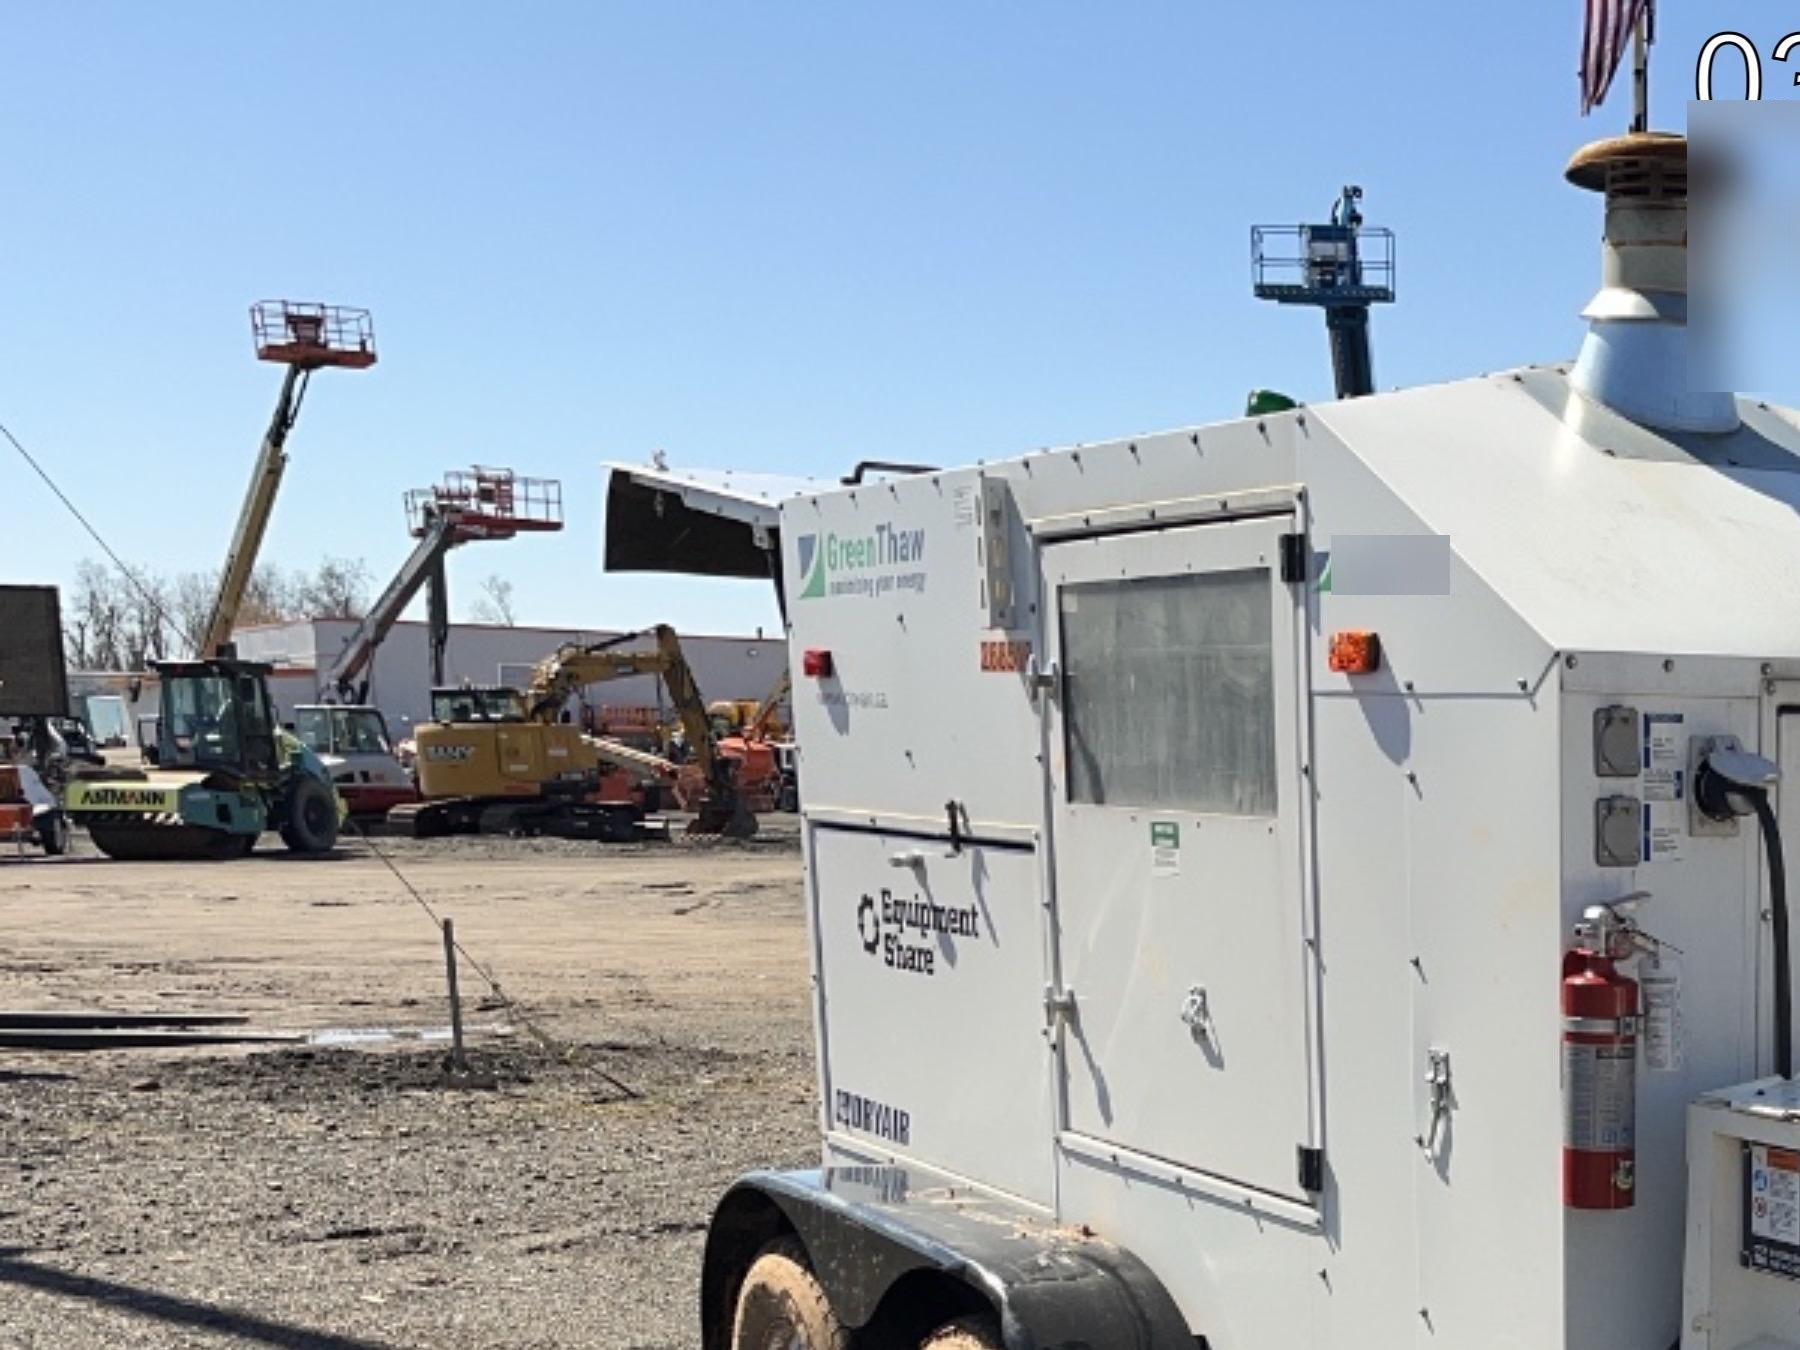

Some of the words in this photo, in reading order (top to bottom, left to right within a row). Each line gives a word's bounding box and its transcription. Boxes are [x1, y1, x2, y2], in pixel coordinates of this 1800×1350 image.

[827, 521, 925, 571] GreenThaw
[881, 888, 979, 939] Equipment
[884, 932, 935, 976] Share
